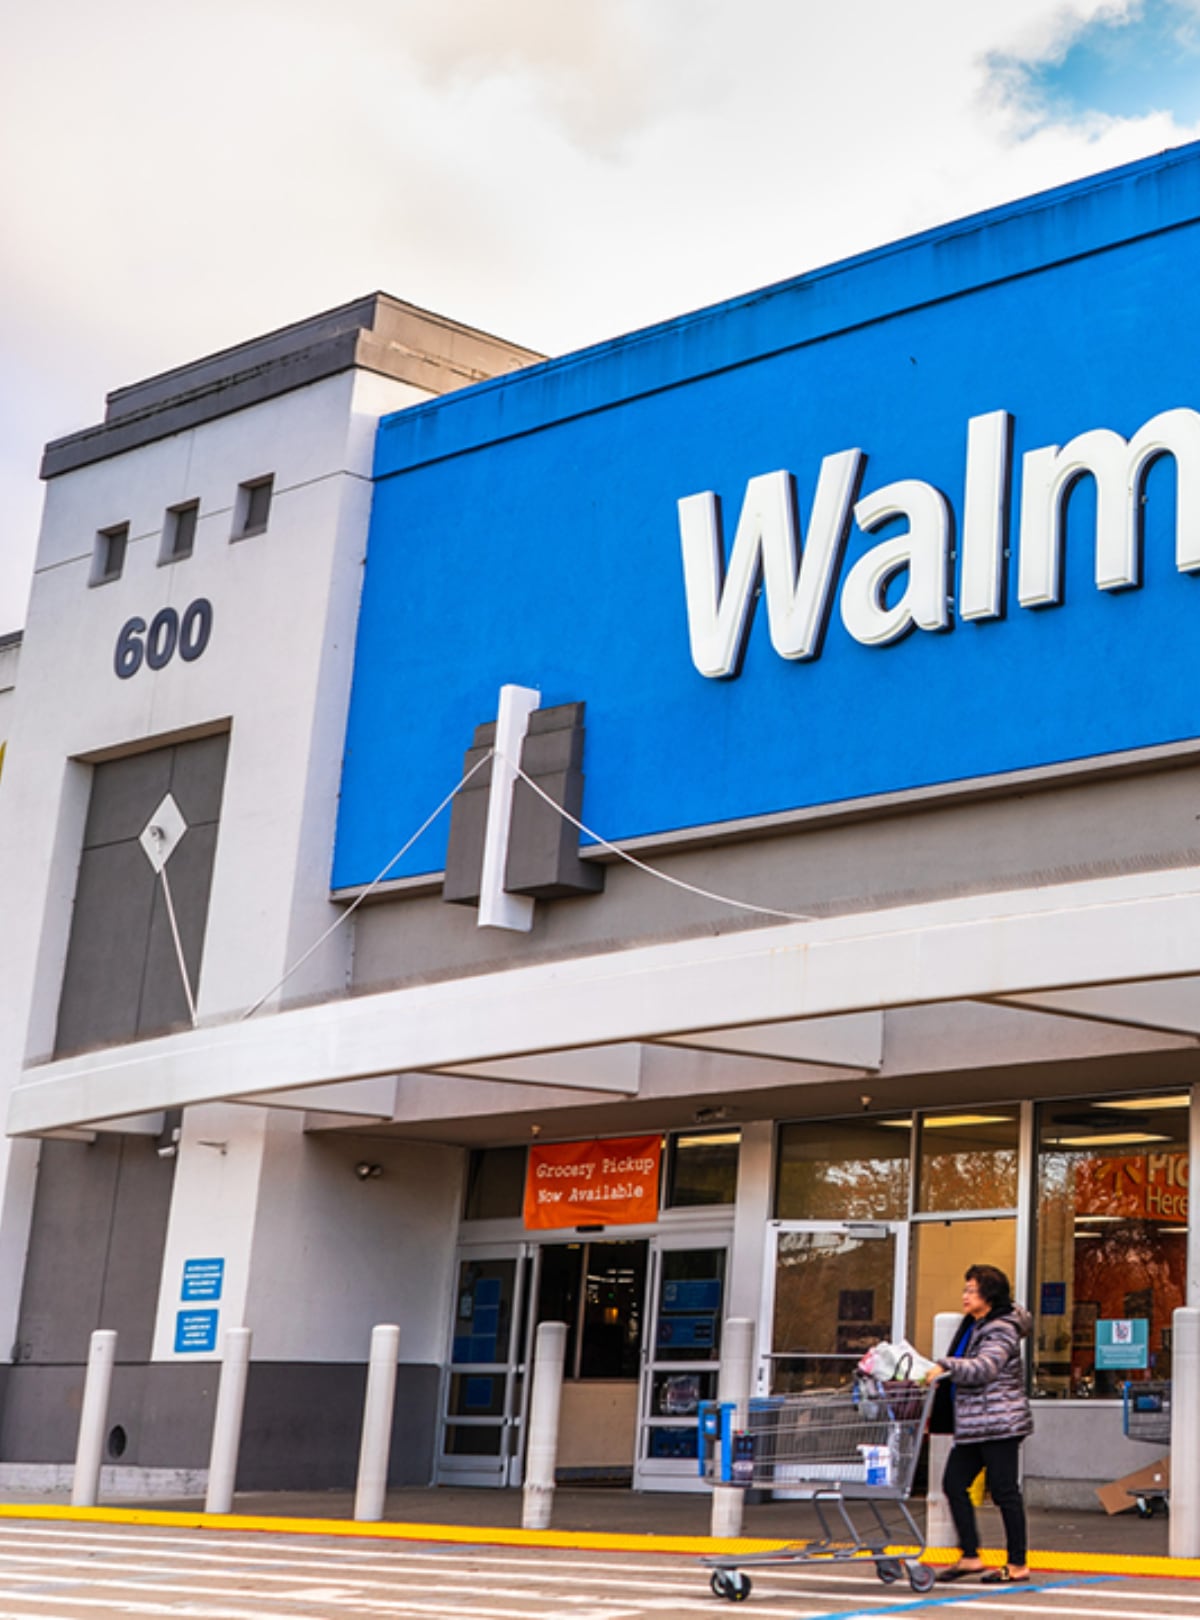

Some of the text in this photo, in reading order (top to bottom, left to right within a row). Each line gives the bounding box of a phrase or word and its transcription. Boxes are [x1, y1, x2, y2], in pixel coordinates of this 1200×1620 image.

[114, 598, 213, 680] 600
[536, 1156, 655, 1180] Grocery Pickup
[537, 1183, 644, 1204] Now Available
